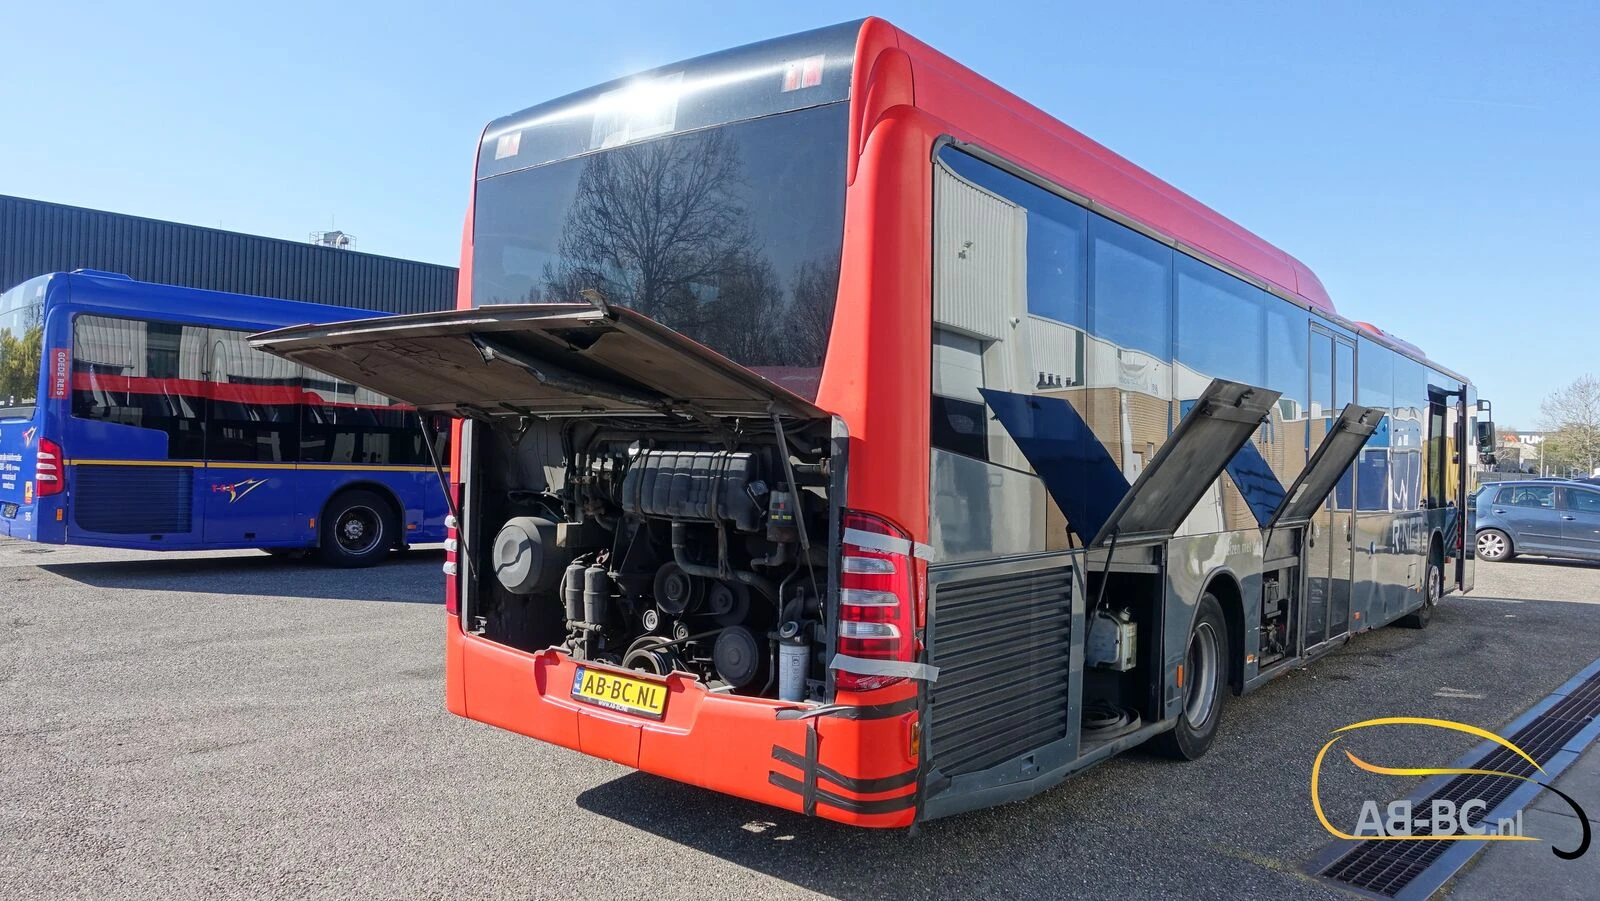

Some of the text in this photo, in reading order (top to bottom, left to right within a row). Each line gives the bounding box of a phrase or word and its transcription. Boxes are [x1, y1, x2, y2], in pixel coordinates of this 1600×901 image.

[56, 351, 66, 396] GOEDE REIS
[583, 674, 658, 708] AB-BC.NL
